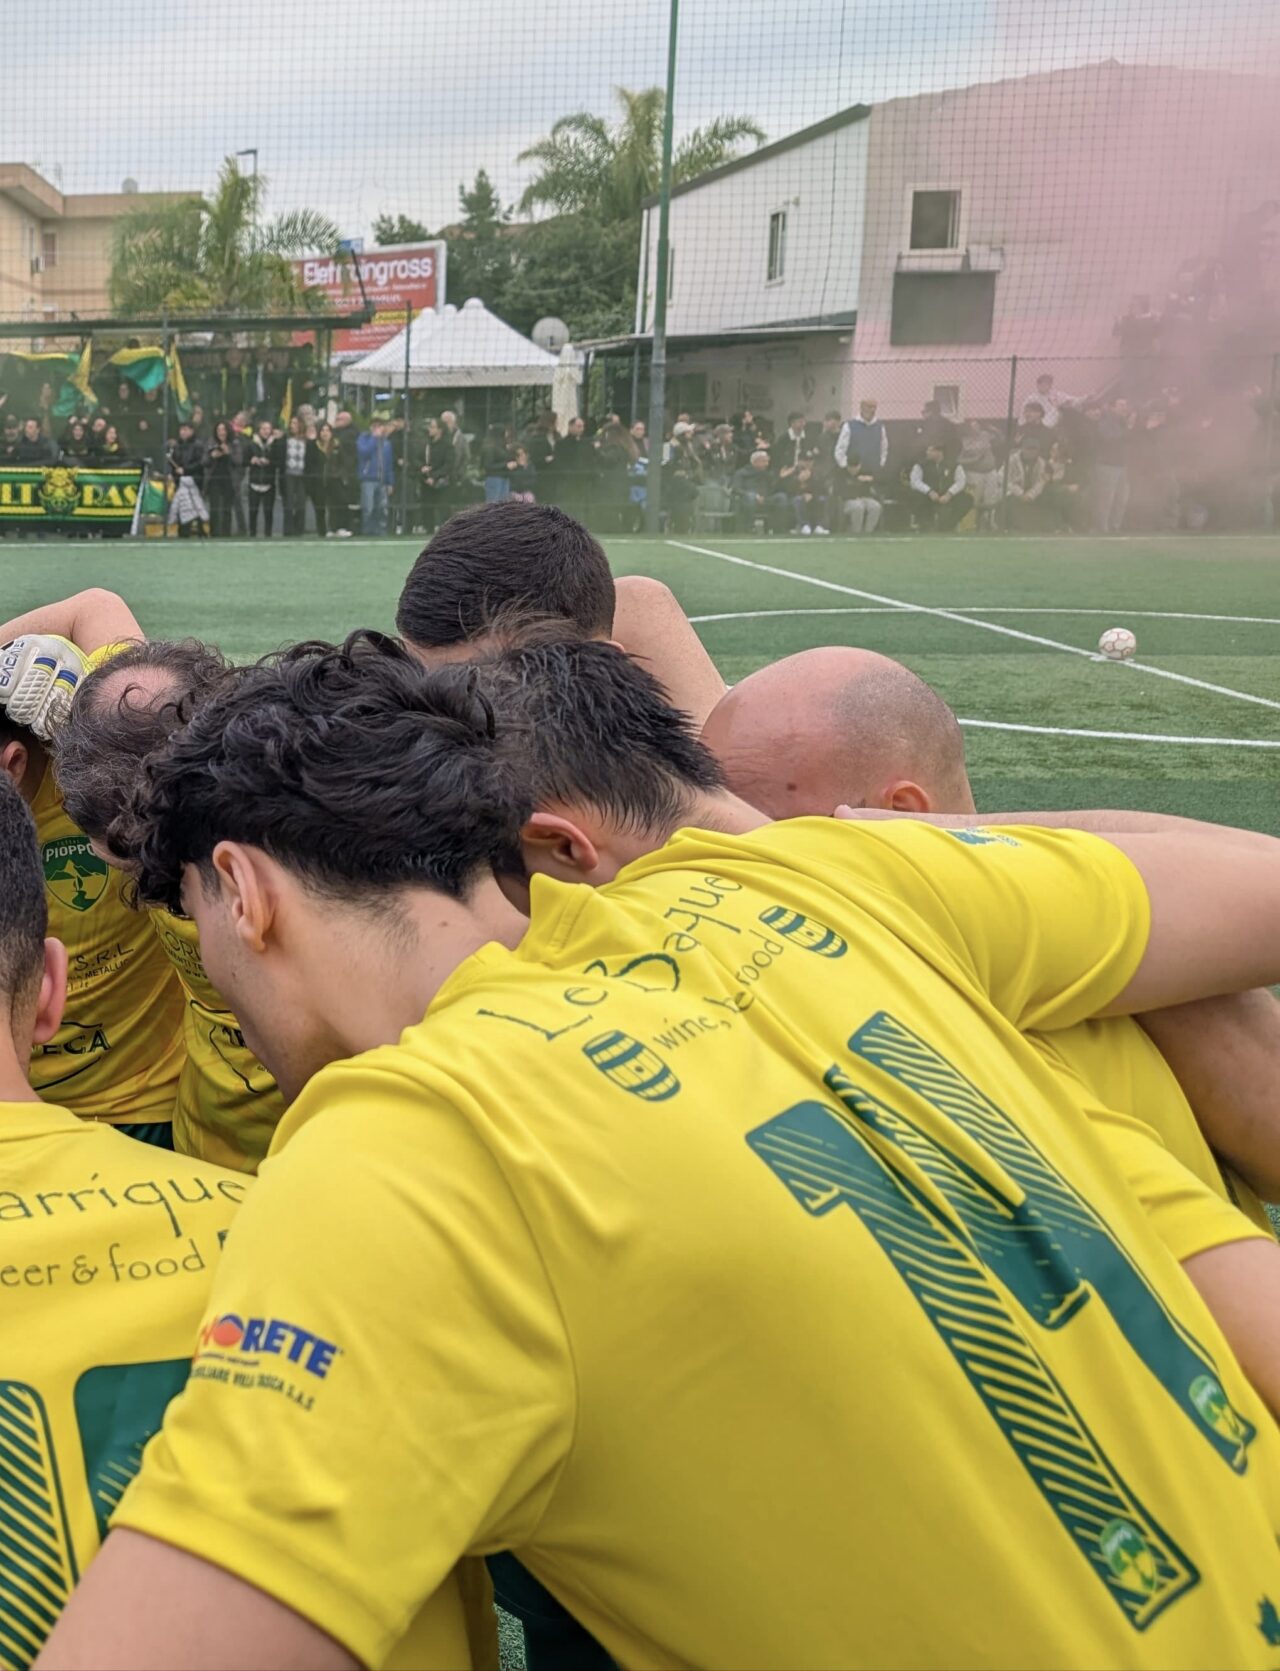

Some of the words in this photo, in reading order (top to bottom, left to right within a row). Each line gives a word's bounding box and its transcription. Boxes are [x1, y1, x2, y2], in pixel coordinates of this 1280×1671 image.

[476, 987, 608, 1042] Le
[72, 1255, 99, 1285] &
[109, 1239, 207, 1283] food
